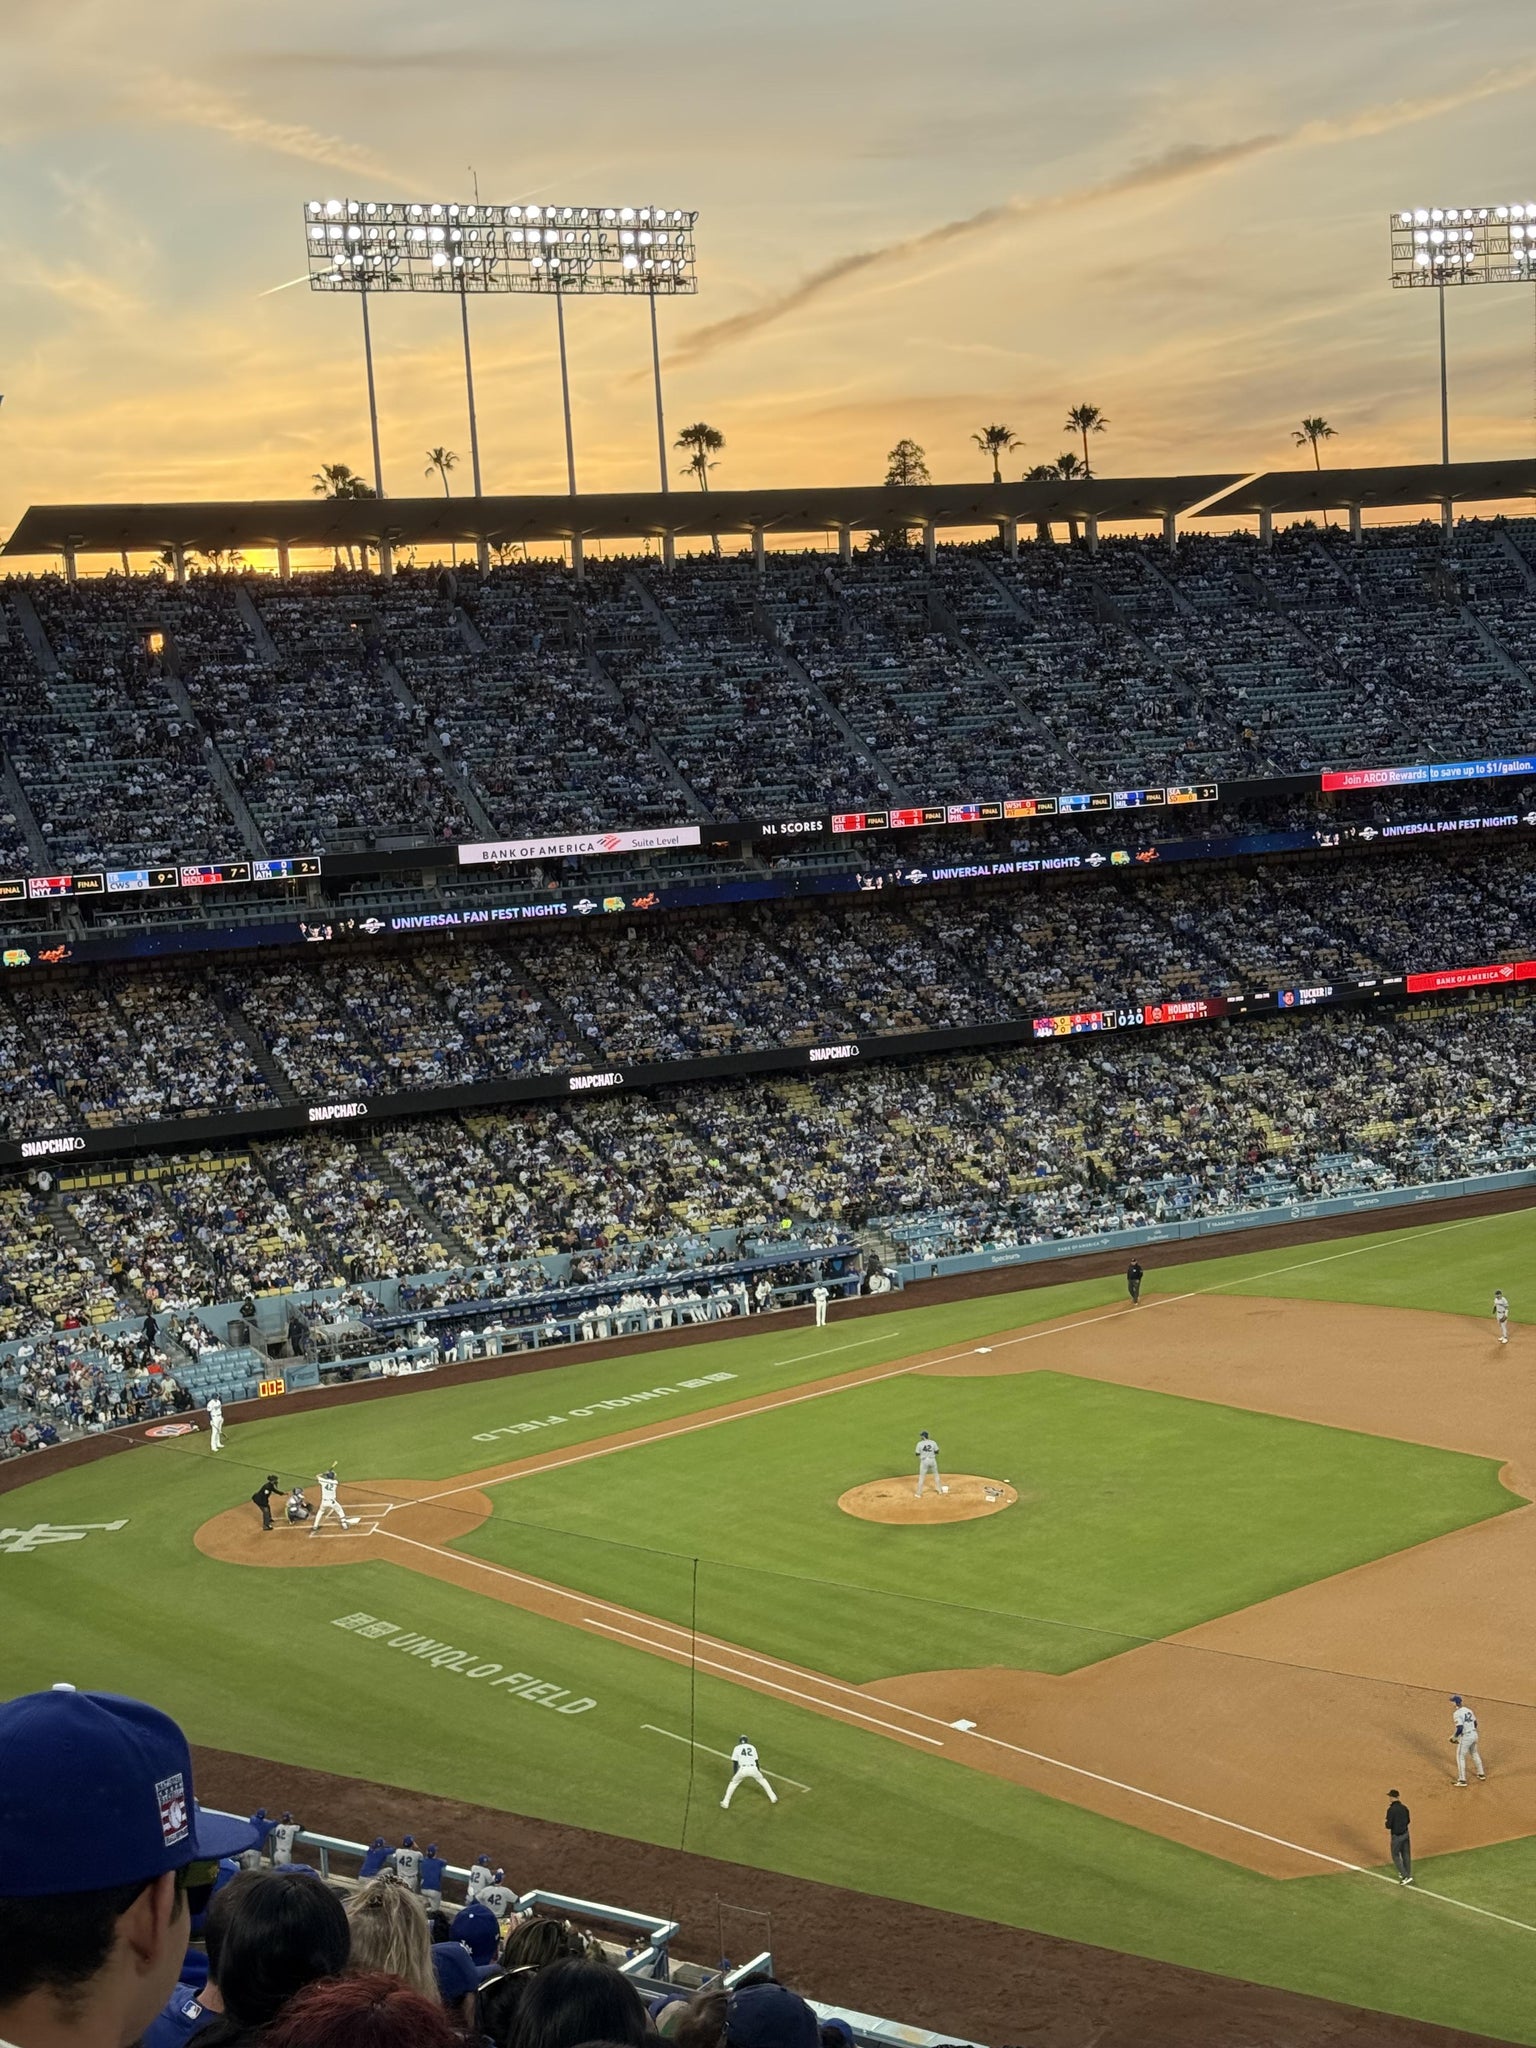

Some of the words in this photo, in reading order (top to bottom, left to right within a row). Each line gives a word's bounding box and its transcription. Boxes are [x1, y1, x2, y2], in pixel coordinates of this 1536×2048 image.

[1343, 774, 1361, 786] Join
[1363, 772, 1388, 784] ARCO
[1389, 770, 1427, 781] Rewards
[1430, 770, 1438, 778] to
[1441, 768, 1461, 777] save
[1463, 767, 1474, 777] up
[1476, 764, 1484, 774] to
[1486, 760, 1534, 776] $1/gallon.
[1203, 790, 1209, 798] 3
[949, 806, 964, 814] CHC
[834, 816, 846, 824] CLE
[868, 817, 884, 826] FINAL
[925, 812, 942, 820] FINAL
[762, 824, 778, 836] NL
[780, 820, 824, 834] SCORES
[1382, 824, 1436, 838] UNIVERSAL
[1437, 820, 1458, 832] FAN
[1458, 818, 1481, 830] FEST
[1482, 816, 1519, 828] NIGHTS
[632, 837, 654, 848] Suite
[656, 835, 680, 846] Level
[482, 849, 517, 861] BANK
[520, 847, 536, 858] OF
[538, 842, 596, 857] AMERICA
[255, 862, 270, 870] TEX
[301, 863, 308, 872] 2
[932, 865, 991, 882] UNIVERSAL
[992, 863, 1015, 876] FAN
[1016, 860, 1040, 873] FEST
[1042, 856, 1080, 870] NIGHTS
[182, 868, 201, 876] COL
[230, 868, 238, 878] 7
[256, 870, 272, 879] ATH
[32, 879, 50, 888] LAA
[60, 878, 66, 886] 4
[109, 874, 120, 882] TB
[158, 874, 166, 884] 9
[183, 876, 204, 884] HOU
[210, 874, 216, 882] 3
[78, 880, 98, 889] FINAL
[110, 881, 130, 890] CWS
[137, 880, 143, 888] 0
[32, 888, 51, 897] NYY
[60, 886, 66, 894] 5
[392, 913, 462, 930] UNIVERSAL
[463, 910, 490, 924] FAN
[492, 908, 521, 922] FEST
[522, 903, 568, 918] NIGHTS
[1436, 976, 1456, 986] BANK
[1456, 975, 1466, 983] OF
[1466, 972, 1499, 982] AMERICA
[1300, 987, 1325, 999] TUCKER
[1168, 1002, 1196, 1015] HOLMES
[1076, 1024, 1082, 1032] 0
[1091, 1022, 1098, 1030] 0
[809, 1046, 851, 1062] SNAPCHAT
[569, 1072, 614, 1090] SNAPCHAT
[308, 1103, 358, 1122] SNAPCHAT
[21, 1138, 74, 1158] SNAPCHAT
[991, 1252, 1018, 1264] Spectrum
[259, 1378, 285, 1398] 003
[568, 1386, 680, 1418] UNIQLO
[472, 1414, 568, 1442] FIELD
[922, 1444, 933, 1452] 42
[324, 1484, 334, 1492] 42
[387, 1632, 504, 1678] UNIQLO
[488, 1672, 598, 1714] FIELD
[1464, 1712, 1474, 1723] 42
[740, 1748, 753, 1756] 42
[276, 1828, 287, 1840] 42
[398, 1856, 412, 1867] 42
[470, 1872, 480, 1884] 42
[488, 1894, 502, 1906] 42
